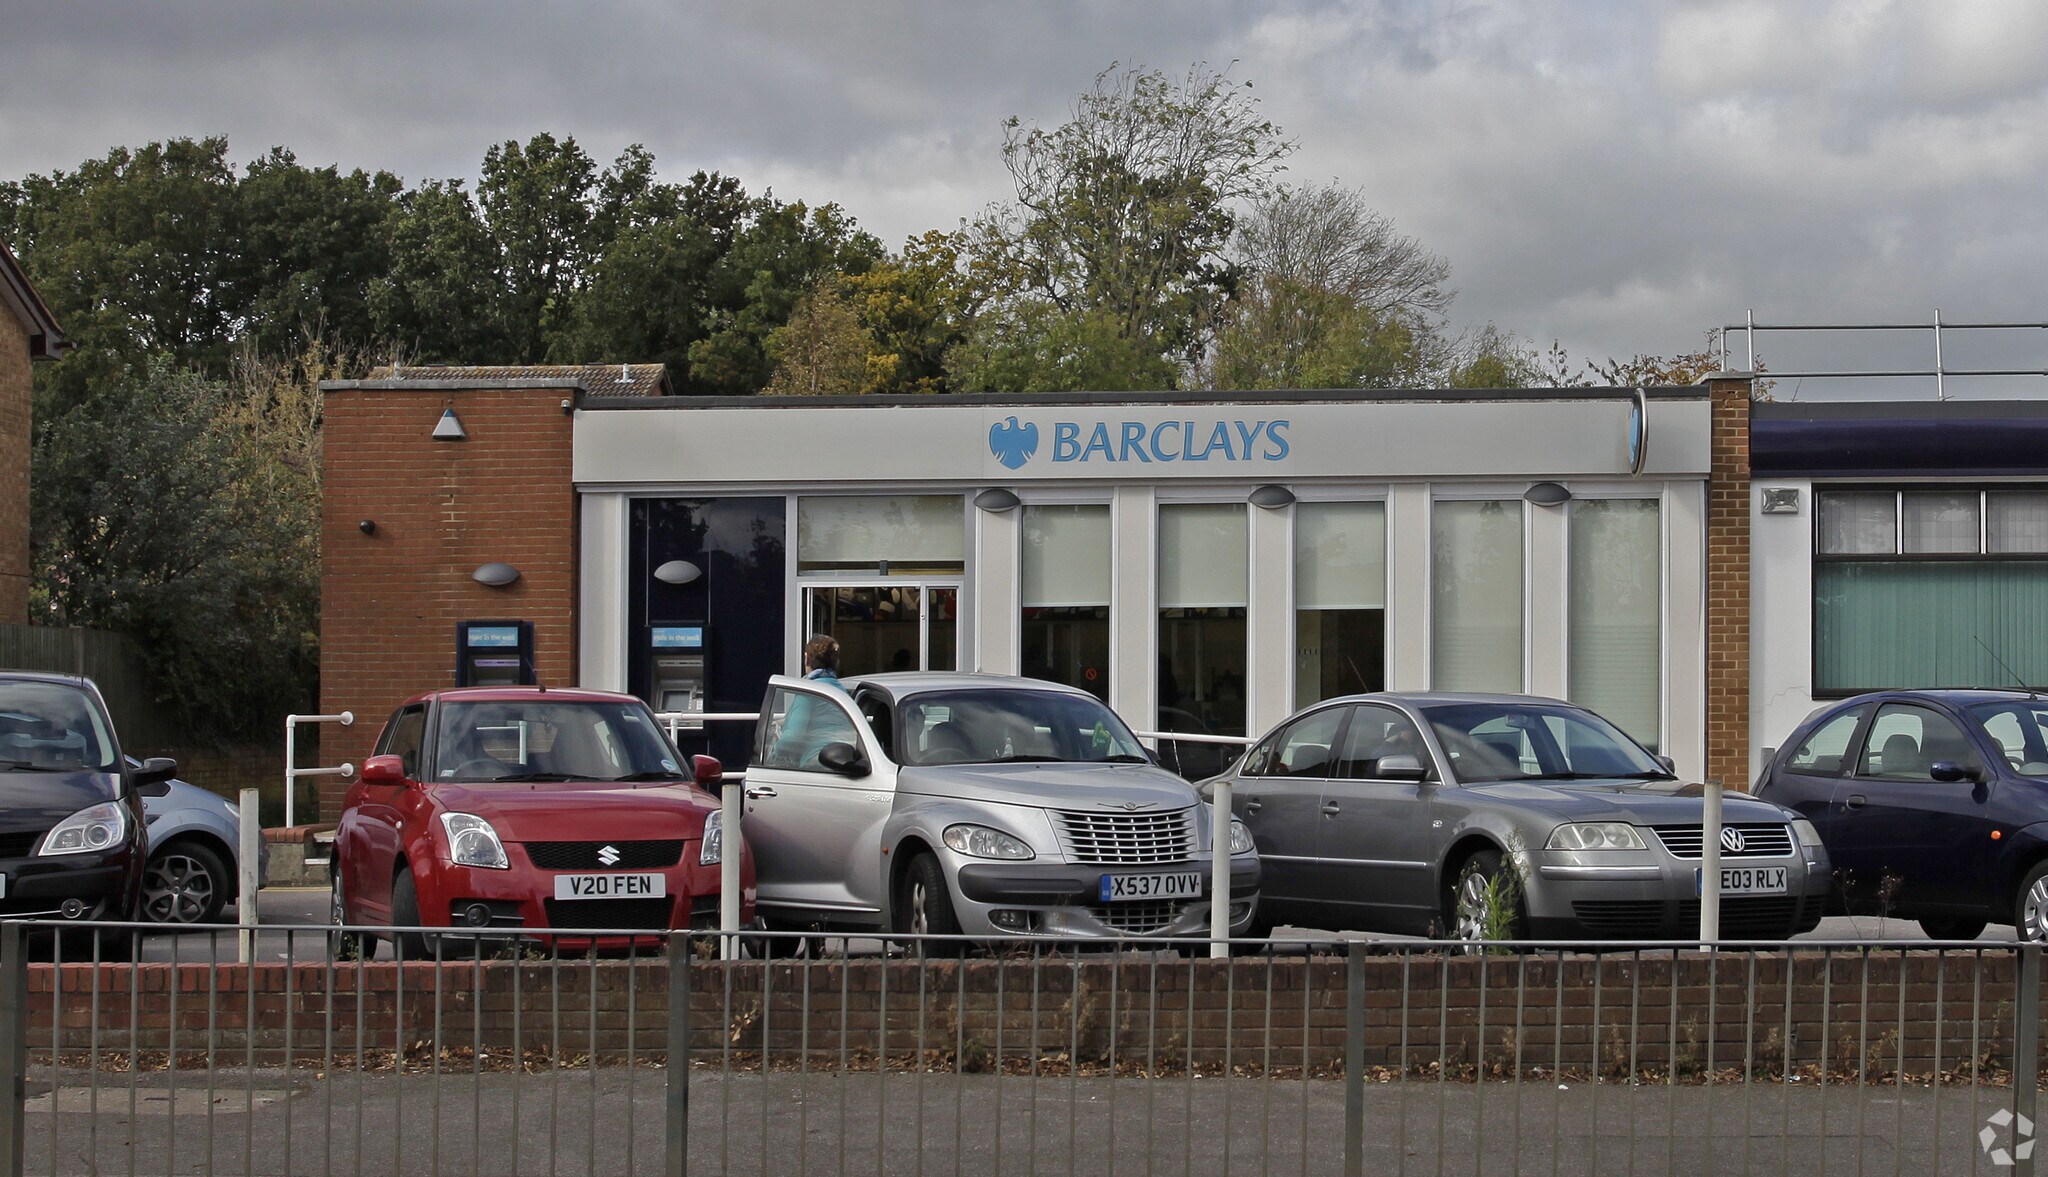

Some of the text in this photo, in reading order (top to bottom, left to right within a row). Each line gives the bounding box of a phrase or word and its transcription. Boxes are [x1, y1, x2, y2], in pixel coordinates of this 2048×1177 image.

[1052, 420, 1289, 463] BARCLAYS
[570, 875, 651, 895] V20 FEN
[1114, 876, 1161, 896] X537
[1720, 869, 1784, 889] E03 RLX
